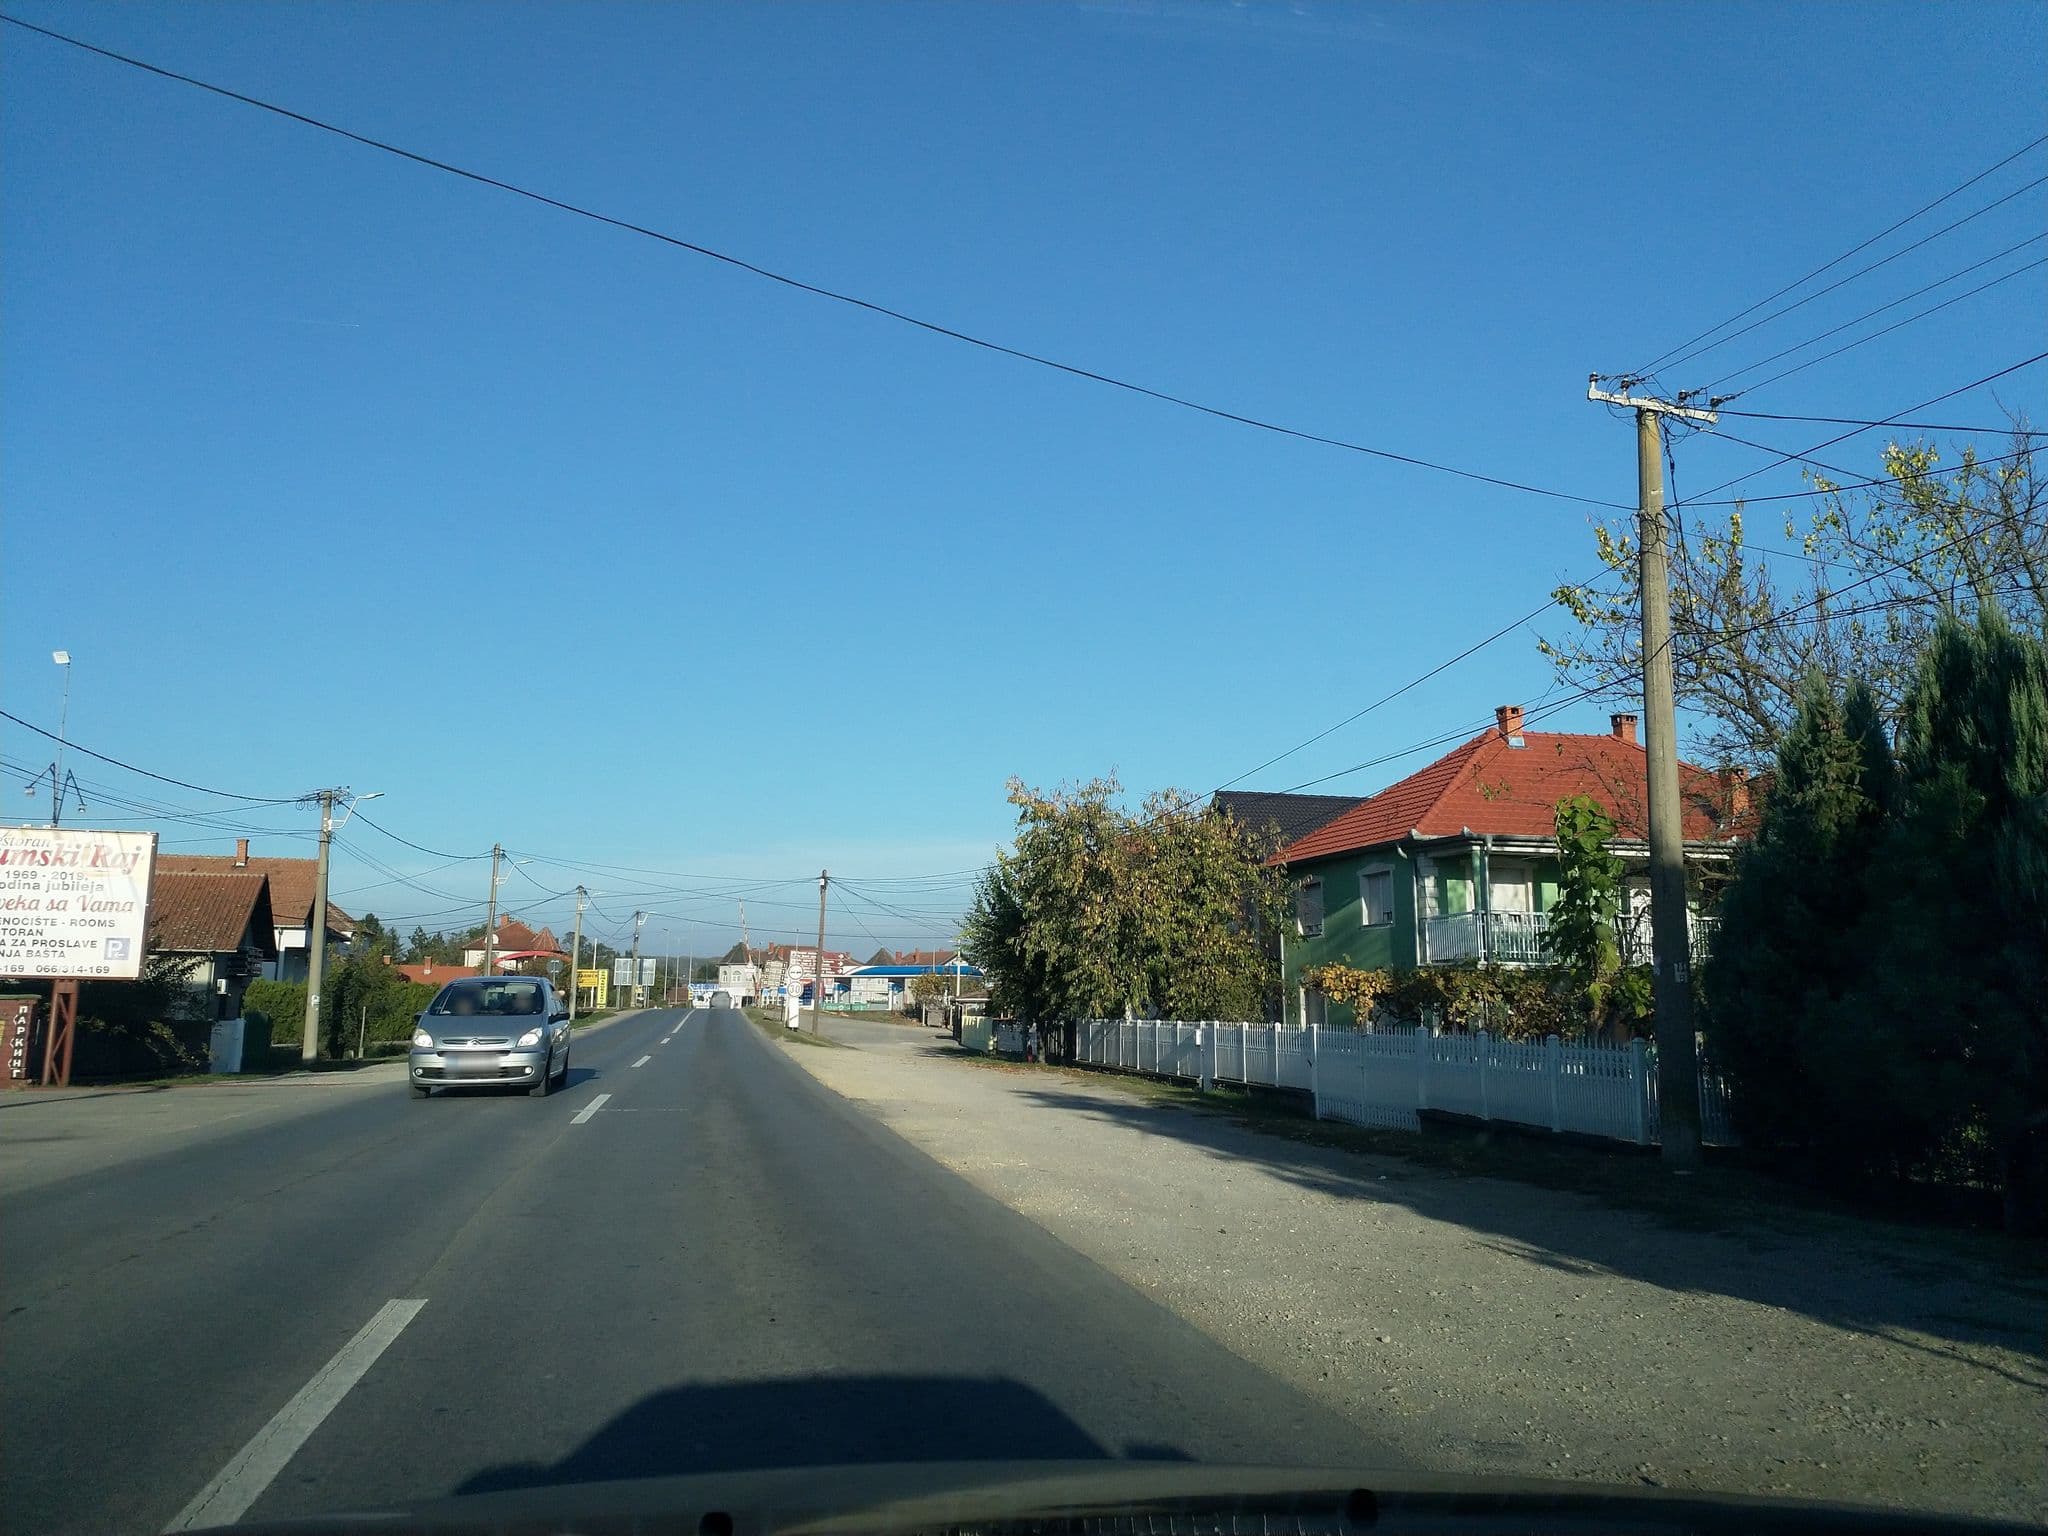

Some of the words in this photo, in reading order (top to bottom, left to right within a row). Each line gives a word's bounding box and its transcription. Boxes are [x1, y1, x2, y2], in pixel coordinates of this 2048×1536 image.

[0, 834, 50, 849] storan
[5, 870, 38, 879] 1969
[45, 880, 105, 893] jubileja
[45, 898, 69, 912] sa
[76, 895, 136, 913] Vama
[69, 918, 116, 928] ROOMS
[1, 928, 44, 937] TORAN
[11, 938, 27, 947] ZA
[31, 939, 98, 949] PROSLAVE
[26, 948, 66, 959] BAŠTA
[12, 1005, 29, 1078] ПАРКИНГ
